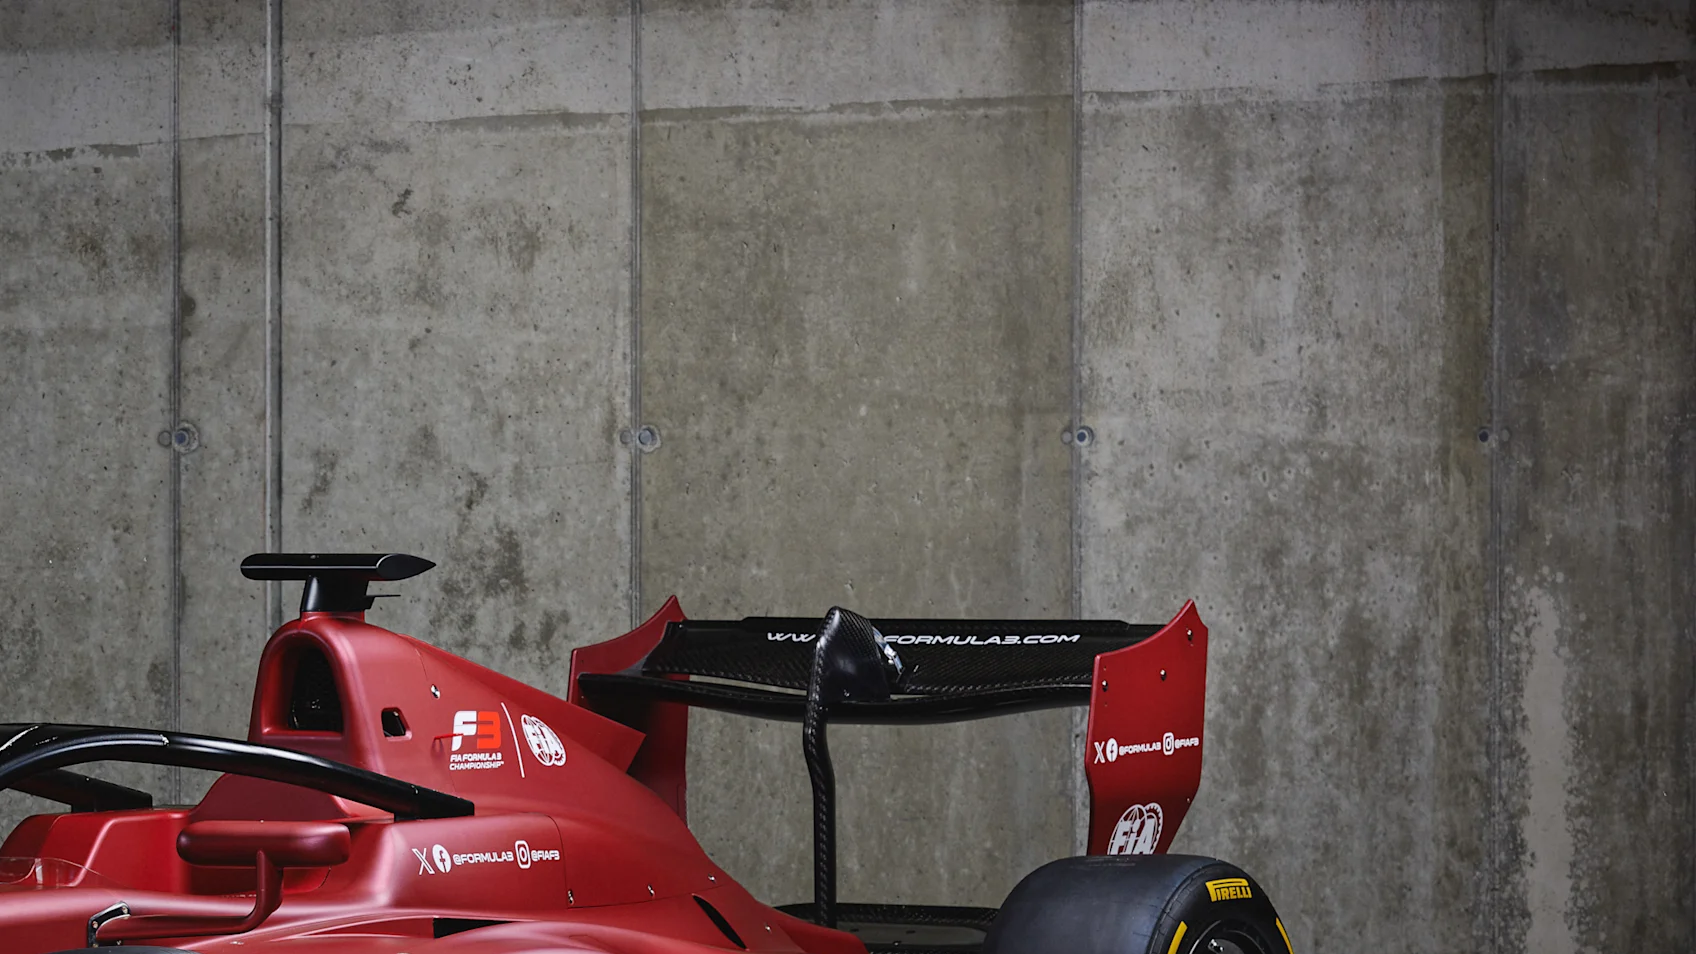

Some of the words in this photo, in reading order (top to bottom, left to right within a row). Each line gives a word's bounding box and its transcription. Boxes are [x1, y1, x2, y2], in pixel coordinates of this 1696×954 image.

[451, 710, 502, 752] F3
[462, 752, 497, 762] FORMULA
[496, 752, 502, 761] 3
[453, 851, 514, 866] @FORMULA3
[531, 850, 560, 862] @FIAF3
[1205, 878, 1252, 902] PIRELLI
